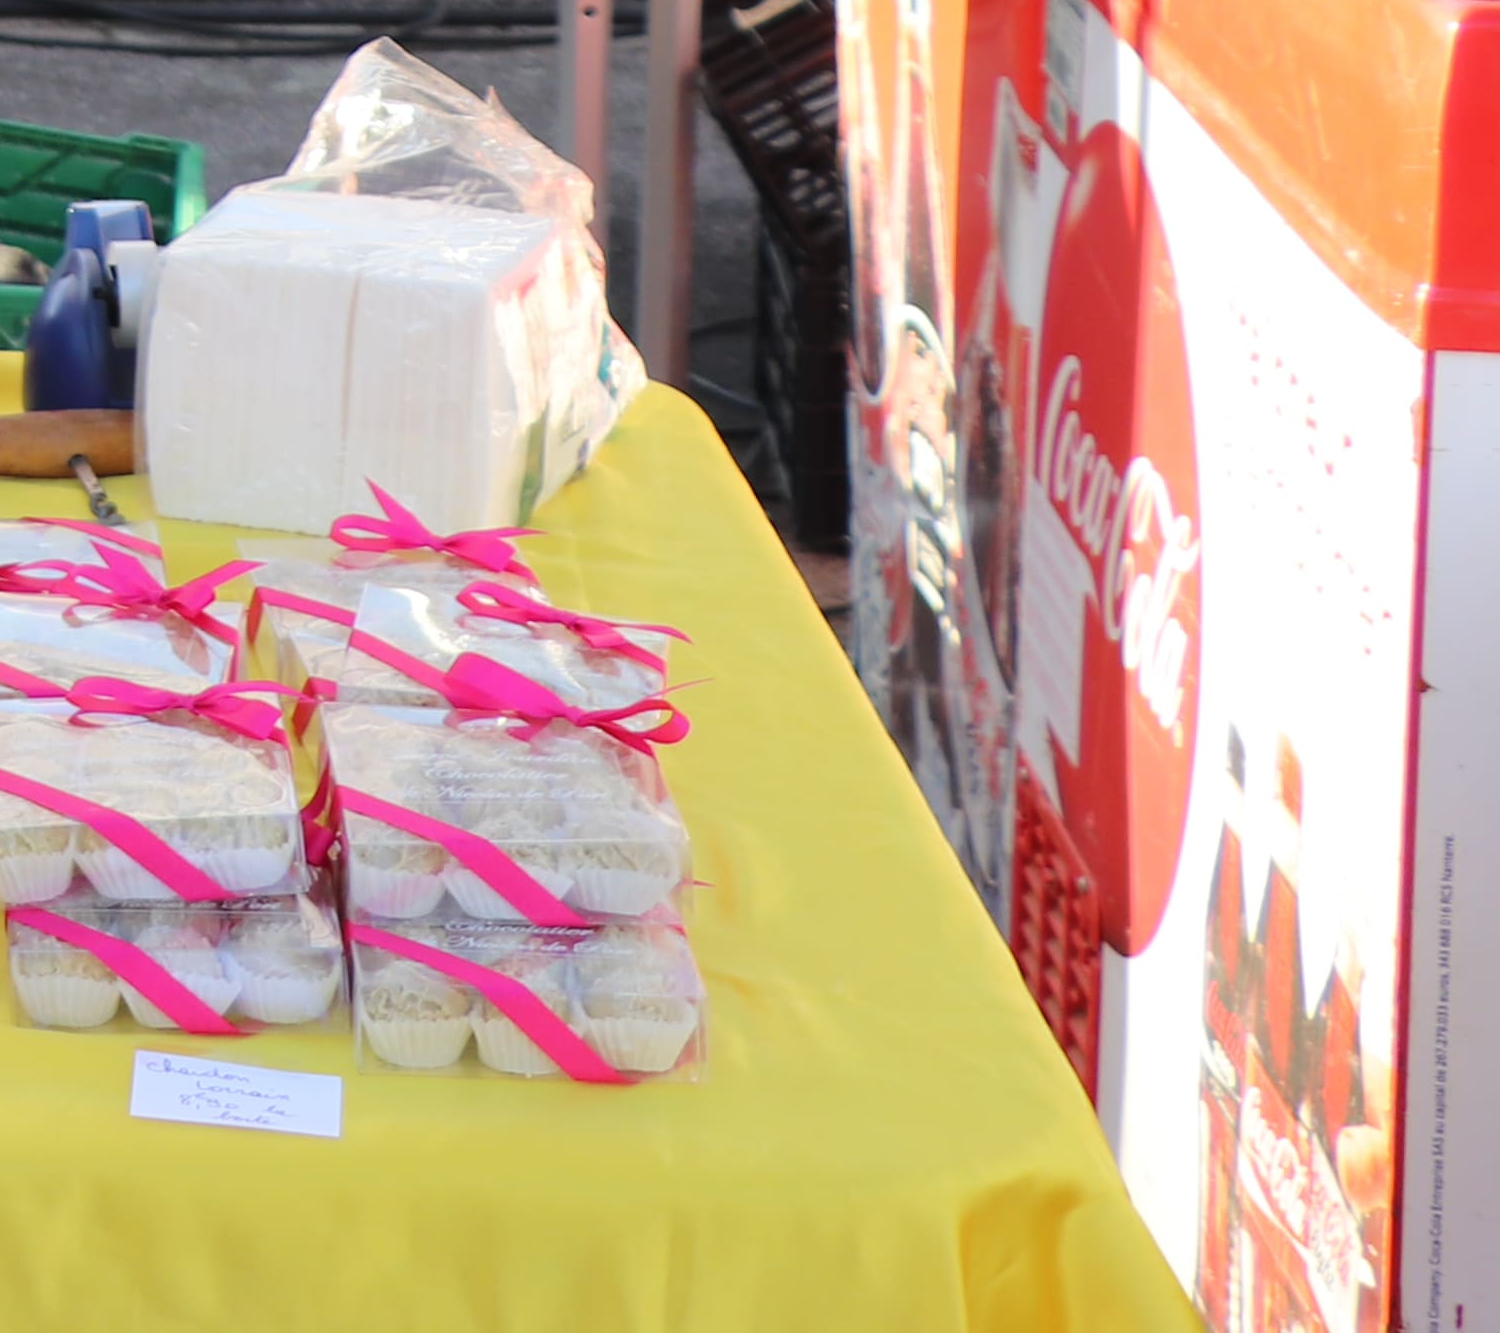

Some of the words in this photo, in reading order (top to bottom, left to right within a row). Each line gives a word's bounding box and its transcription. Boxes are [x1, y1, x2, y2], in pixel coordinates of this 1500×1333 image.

[1439, 885, 1452, 905] RCS
[1434, 1070, 1447, 1084] de
[1434, 1085, 1447, 1120] capital
